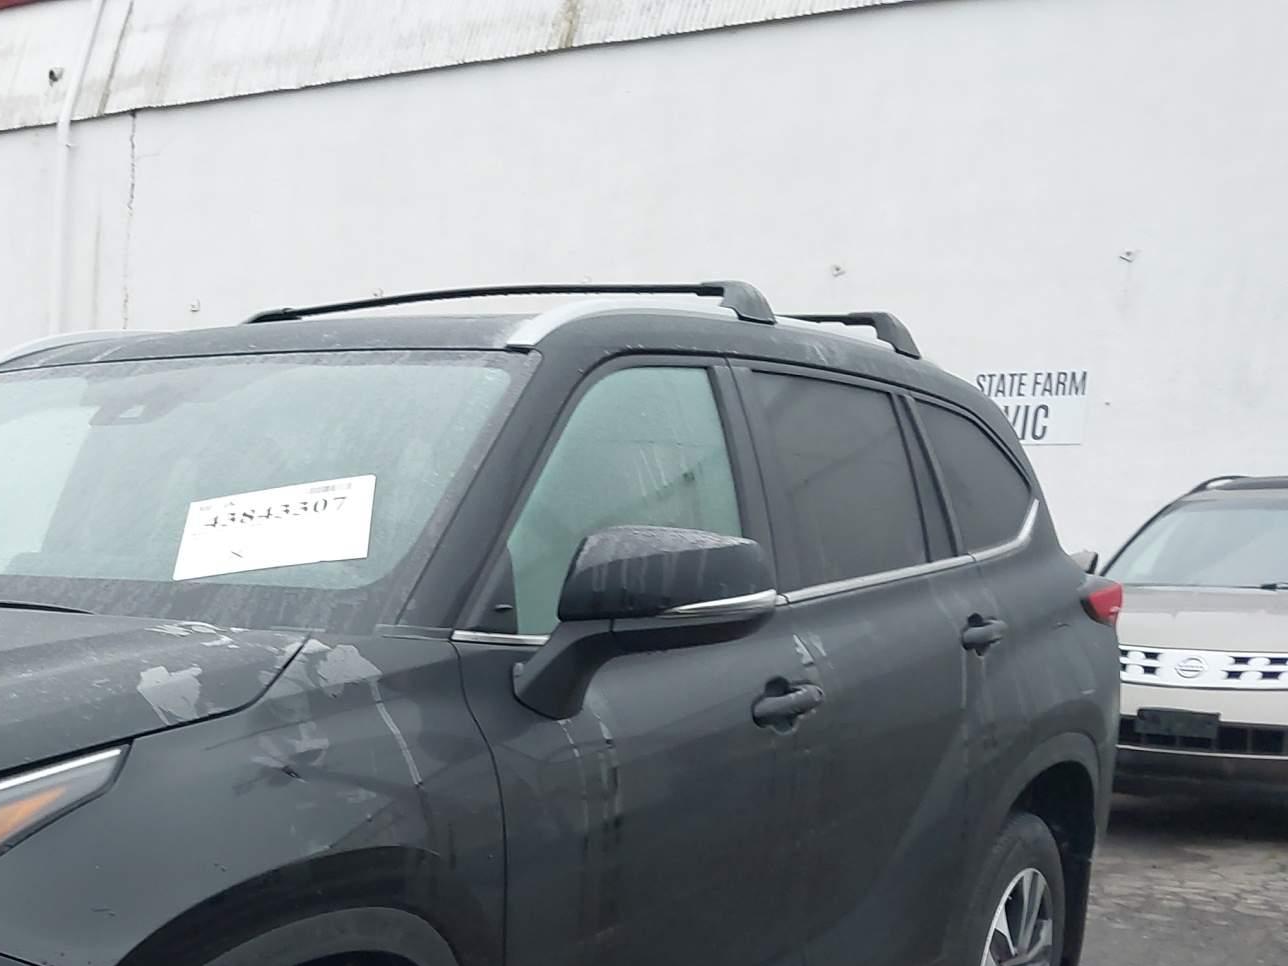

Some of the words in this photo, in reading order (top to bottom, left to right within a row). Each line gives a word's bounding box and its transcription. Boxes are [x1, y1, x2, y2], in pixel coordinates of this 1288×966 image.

[976, 372, 1028, 398] STATE
[1031, 370, 1088, 397] FARM
[203, 495, 348, 529] 43843307
